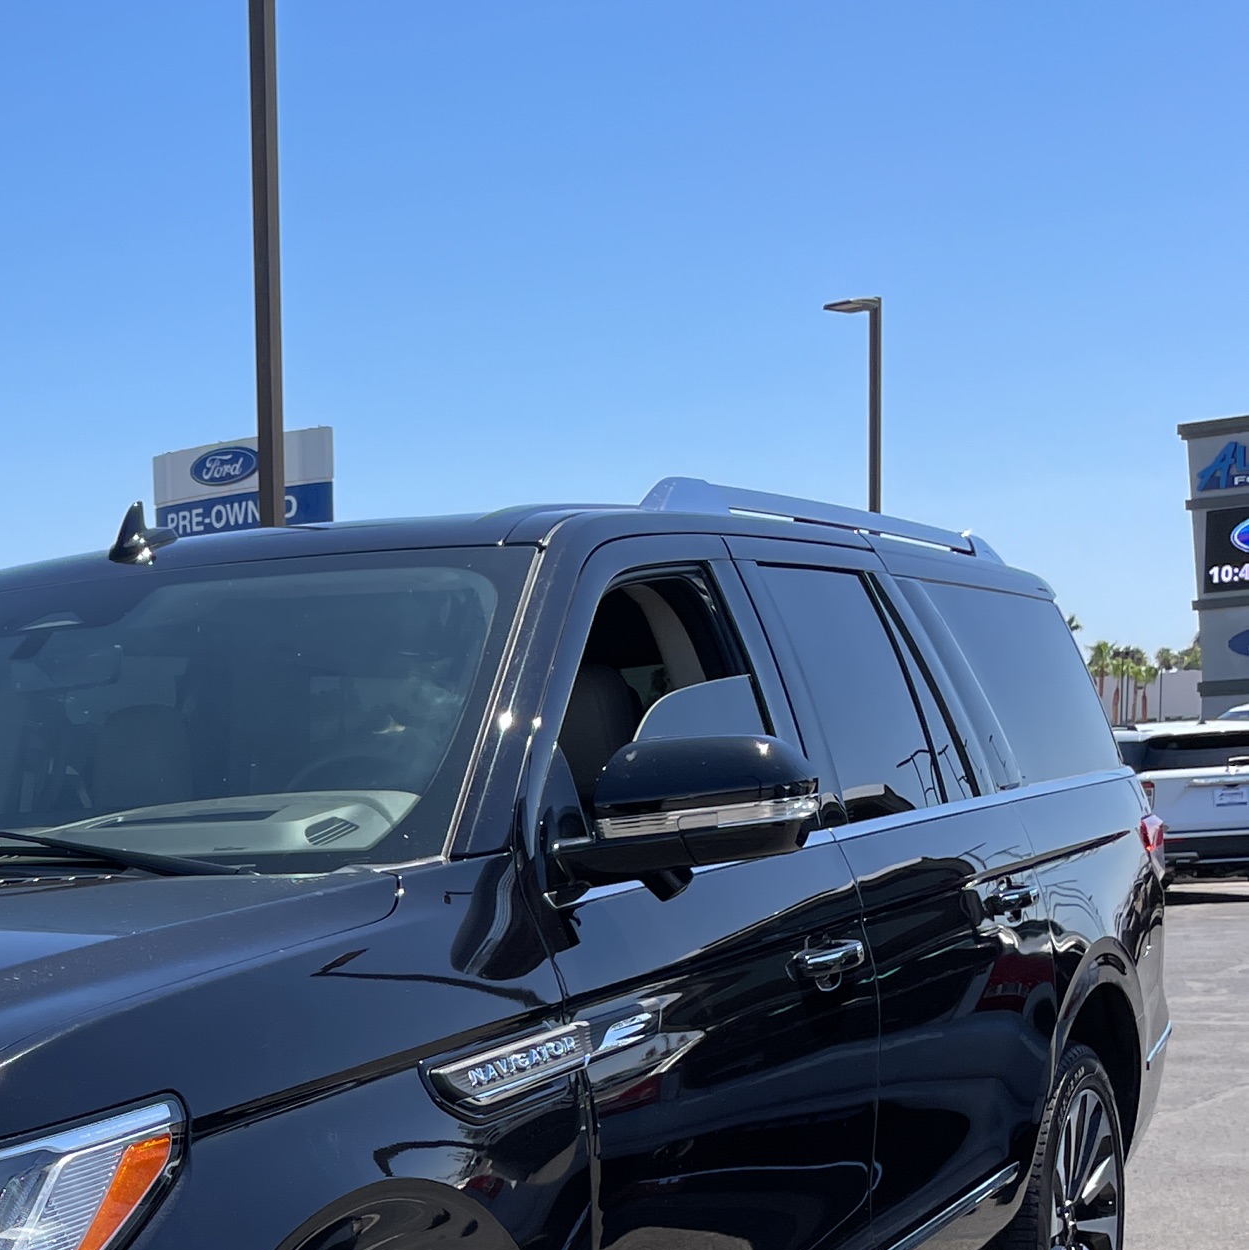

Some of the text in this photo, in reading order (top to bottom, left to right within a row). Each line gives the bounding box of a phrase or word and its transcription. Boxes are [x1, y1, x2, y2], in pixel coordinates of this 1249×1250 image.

[202, 454, 243, 480] Ford
[167, 495, 297, 535] PRE-OWND
[468, 1036, 577, 1087] NAVIGATOR
